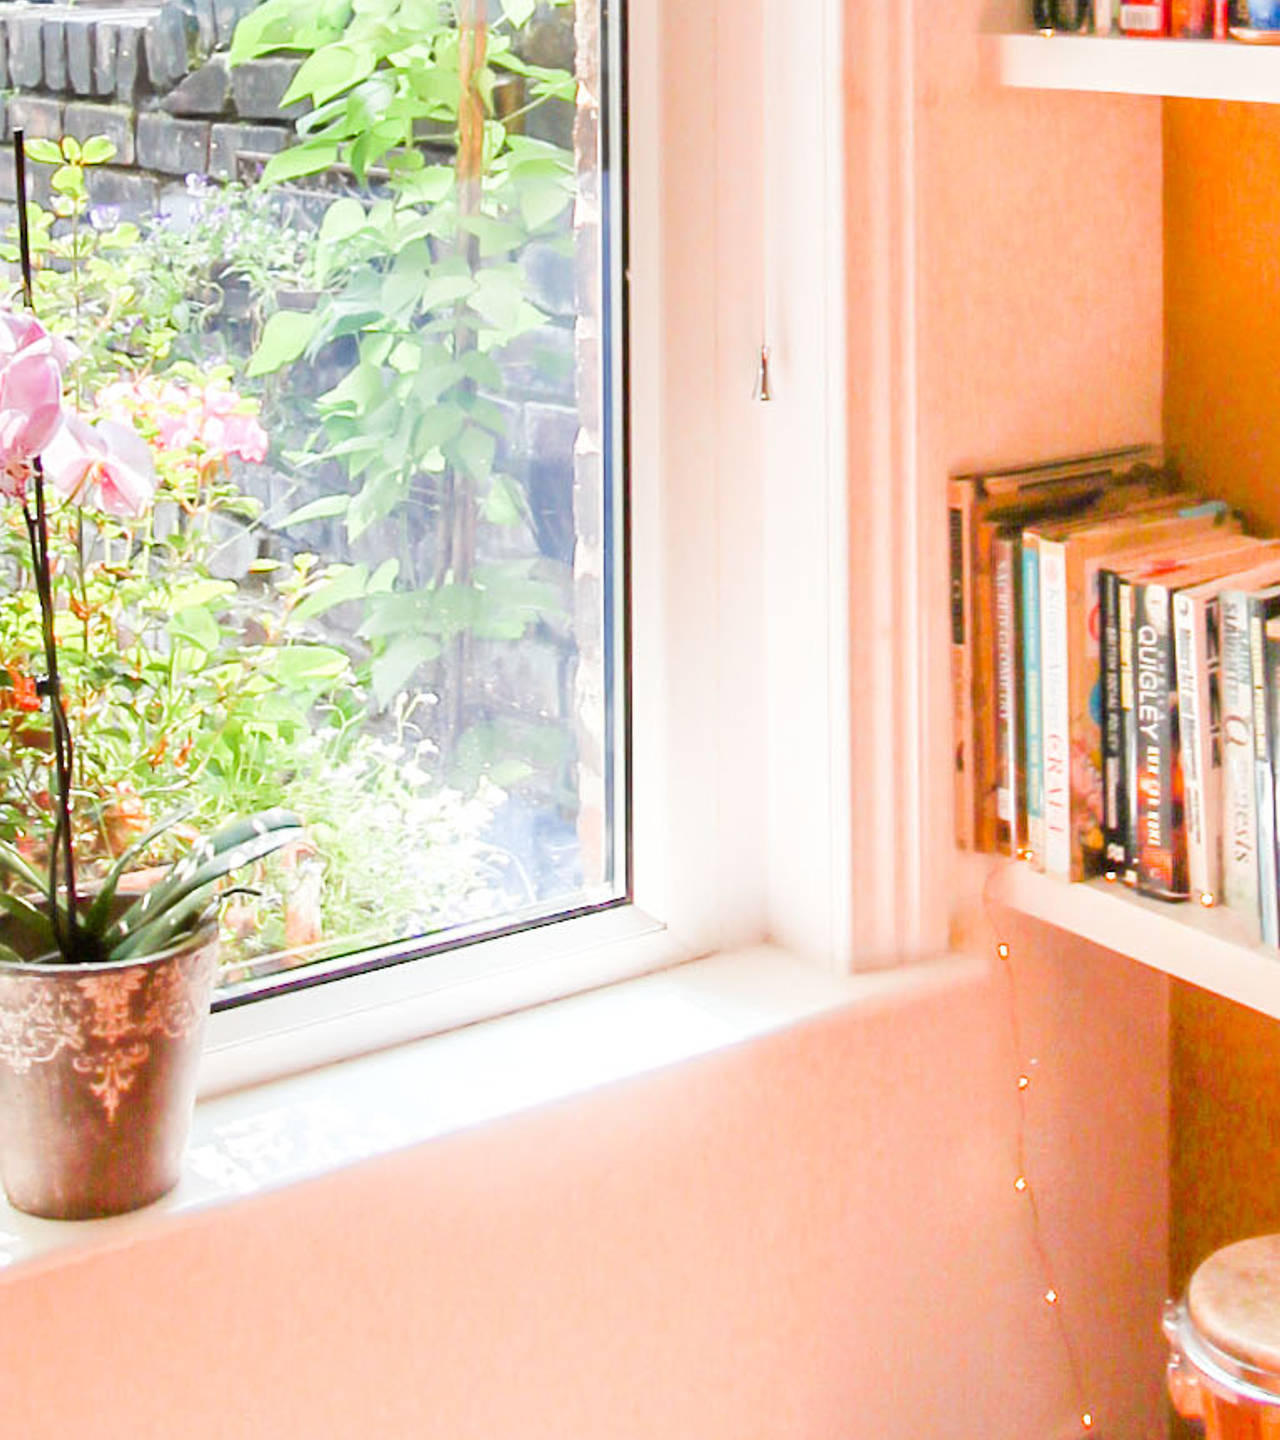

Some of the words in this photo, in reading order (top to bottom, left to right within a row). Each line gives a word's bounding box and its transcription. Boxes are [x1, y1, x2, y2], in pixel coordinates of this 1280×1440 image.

[996, 559, 1010, 626] SACRED
[997, 630, 1010, 720] GEOMETRY
[1105, 627, 1118, 670] BRITISH
[1106, 673, 1118, 710] SOCIAL
[1137, 625, 1160, 742] QUIGLEY
[1107, 713, 1118, 751] POLICY
